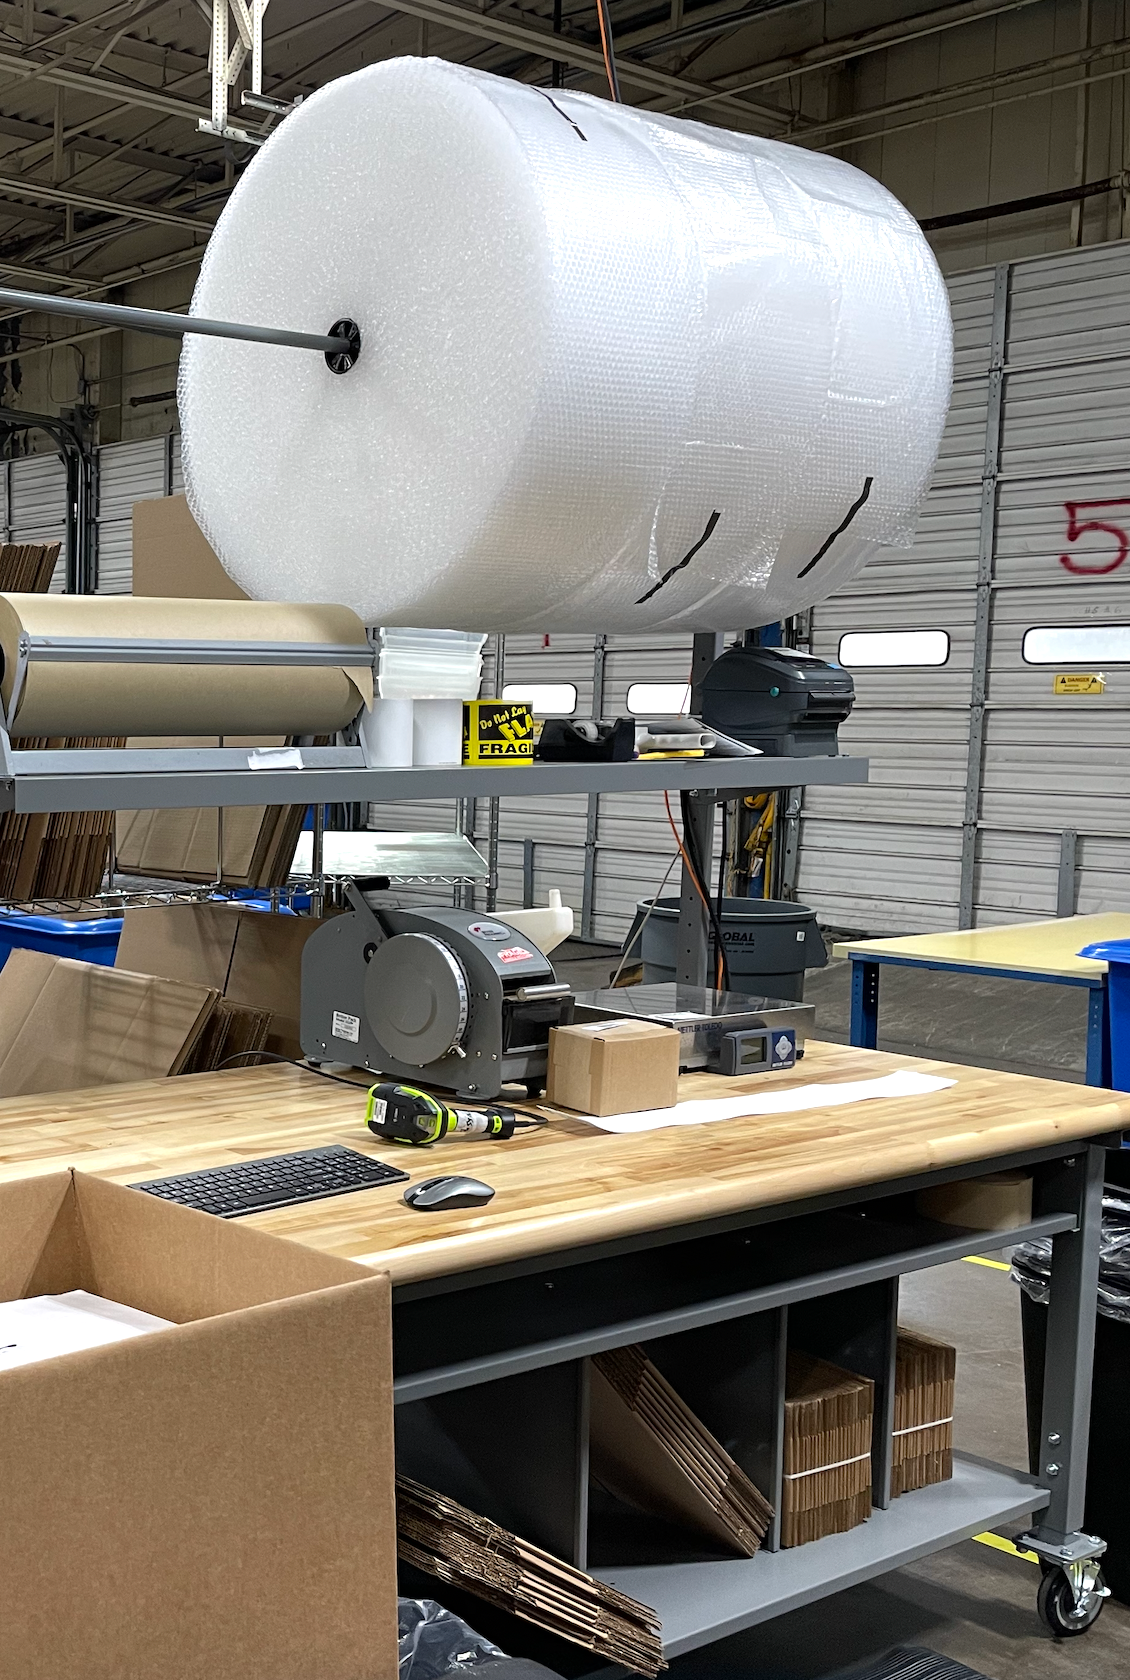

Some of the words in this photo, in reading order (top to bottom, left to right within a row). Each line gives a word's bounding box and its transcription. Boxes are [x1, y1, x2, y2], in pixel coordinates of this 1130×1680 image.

[1059, 499, 1130, 575] 5
[479, 720, 492, 730] Do
[493, 710, 510, 724] Not
[511, 706, 527, 718] Lay
[708, 931, 755, 942] GOBAL
